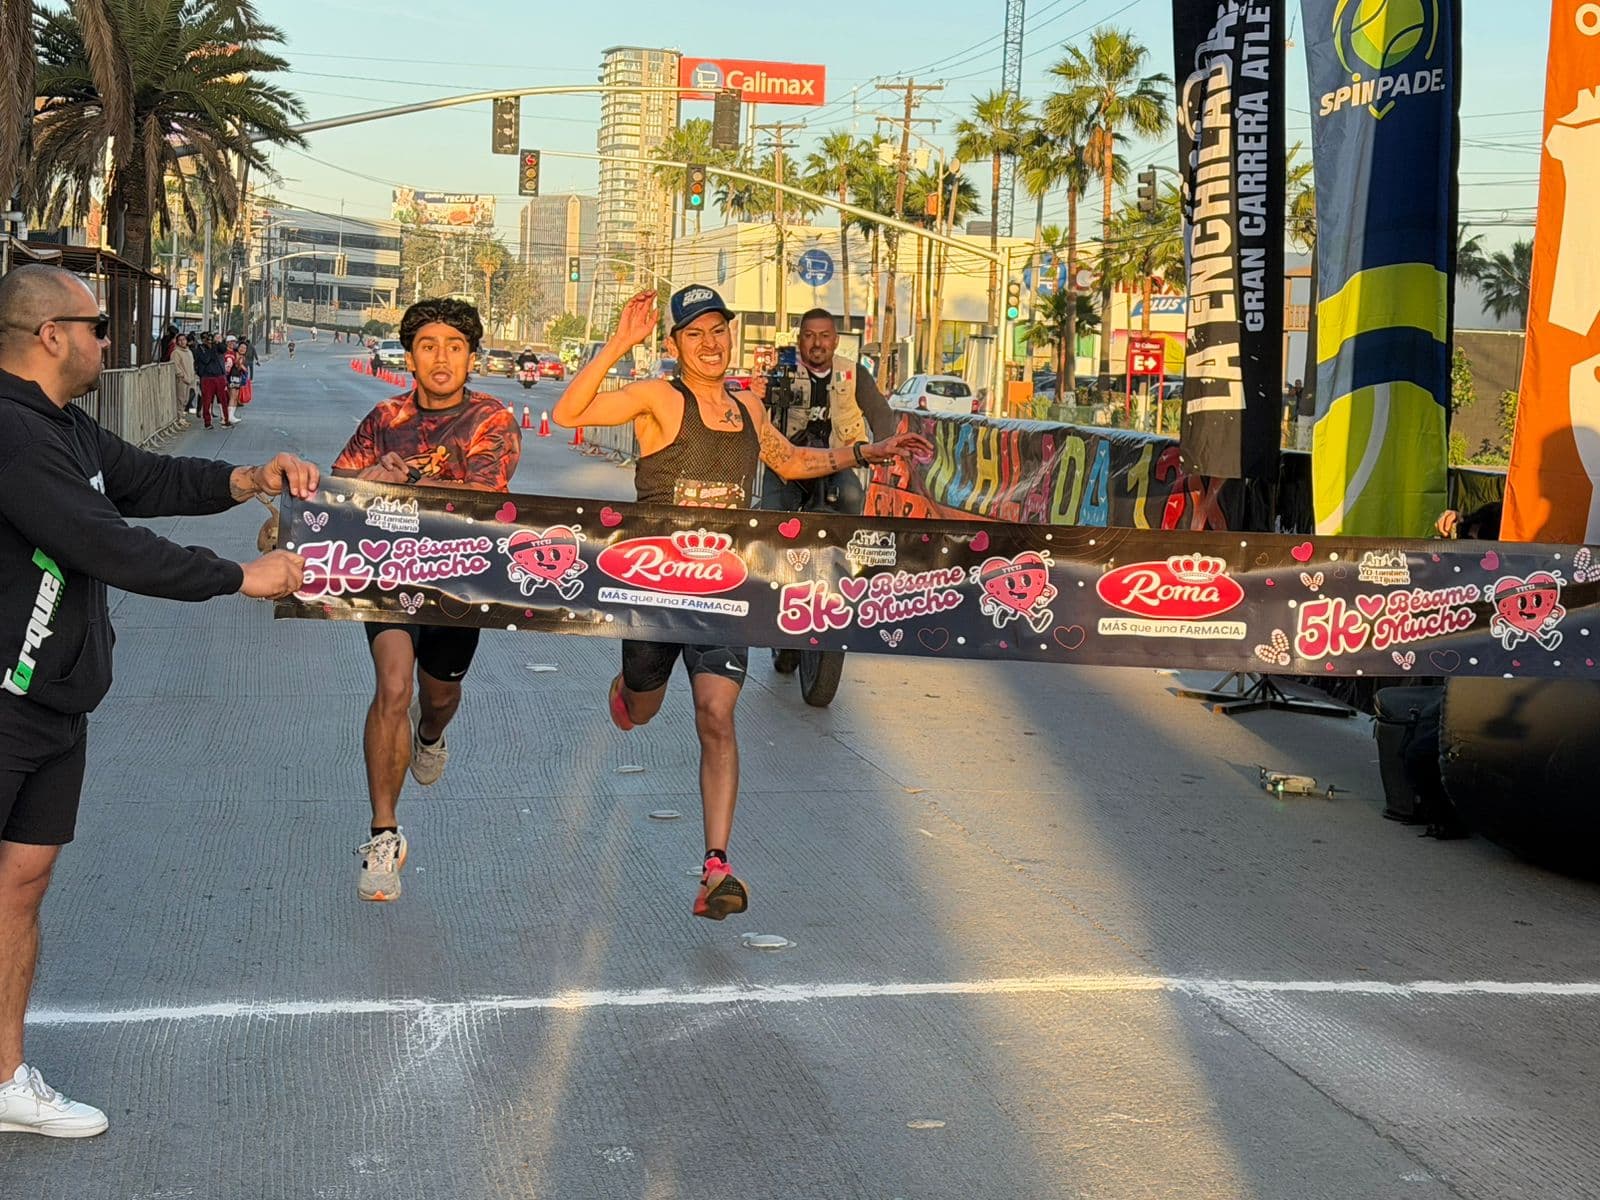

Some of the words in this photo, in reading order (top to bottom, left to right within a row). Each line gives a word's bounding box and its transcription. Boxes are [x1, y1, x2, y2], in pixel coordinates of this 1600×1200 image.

[726, 70, 816, 96] Calimax
[1188, 10, 1239, 328] ENCHILADA
[1238, 91, 1269, 237] CARRERA
[1242, 248, 1266, 333] GRAN
[1134, 355, 1145, 371] E
[1186, 343, 1247, 415] LA
[391, 537, 492, 560] Bésame
[621, 545, 723, 582] Roma
[294, 541, 373, 599] 5k
[379, 554, 490, 590] Mucho
[869, 566, 965, 599] Bésame
[1121, 570, 1220, 606] Roma
[600, 591, 628, 601] MÁS
[630, 593, 654, 605] que
[656, 596, 679, 606] una
[777, 580, 853, 634] 5k
[858, 590, 963, 628] Mucho
[1385, 584, 1480, 618] Bésame
[1101, 621, 1128, 631] MÁS
[1130, 623, 1152, 635] que
[1155, 625, 1177, 634] una
[1295, 598, 1370, 660] 5k
[1372, 606, 1476, 650] Mucho
